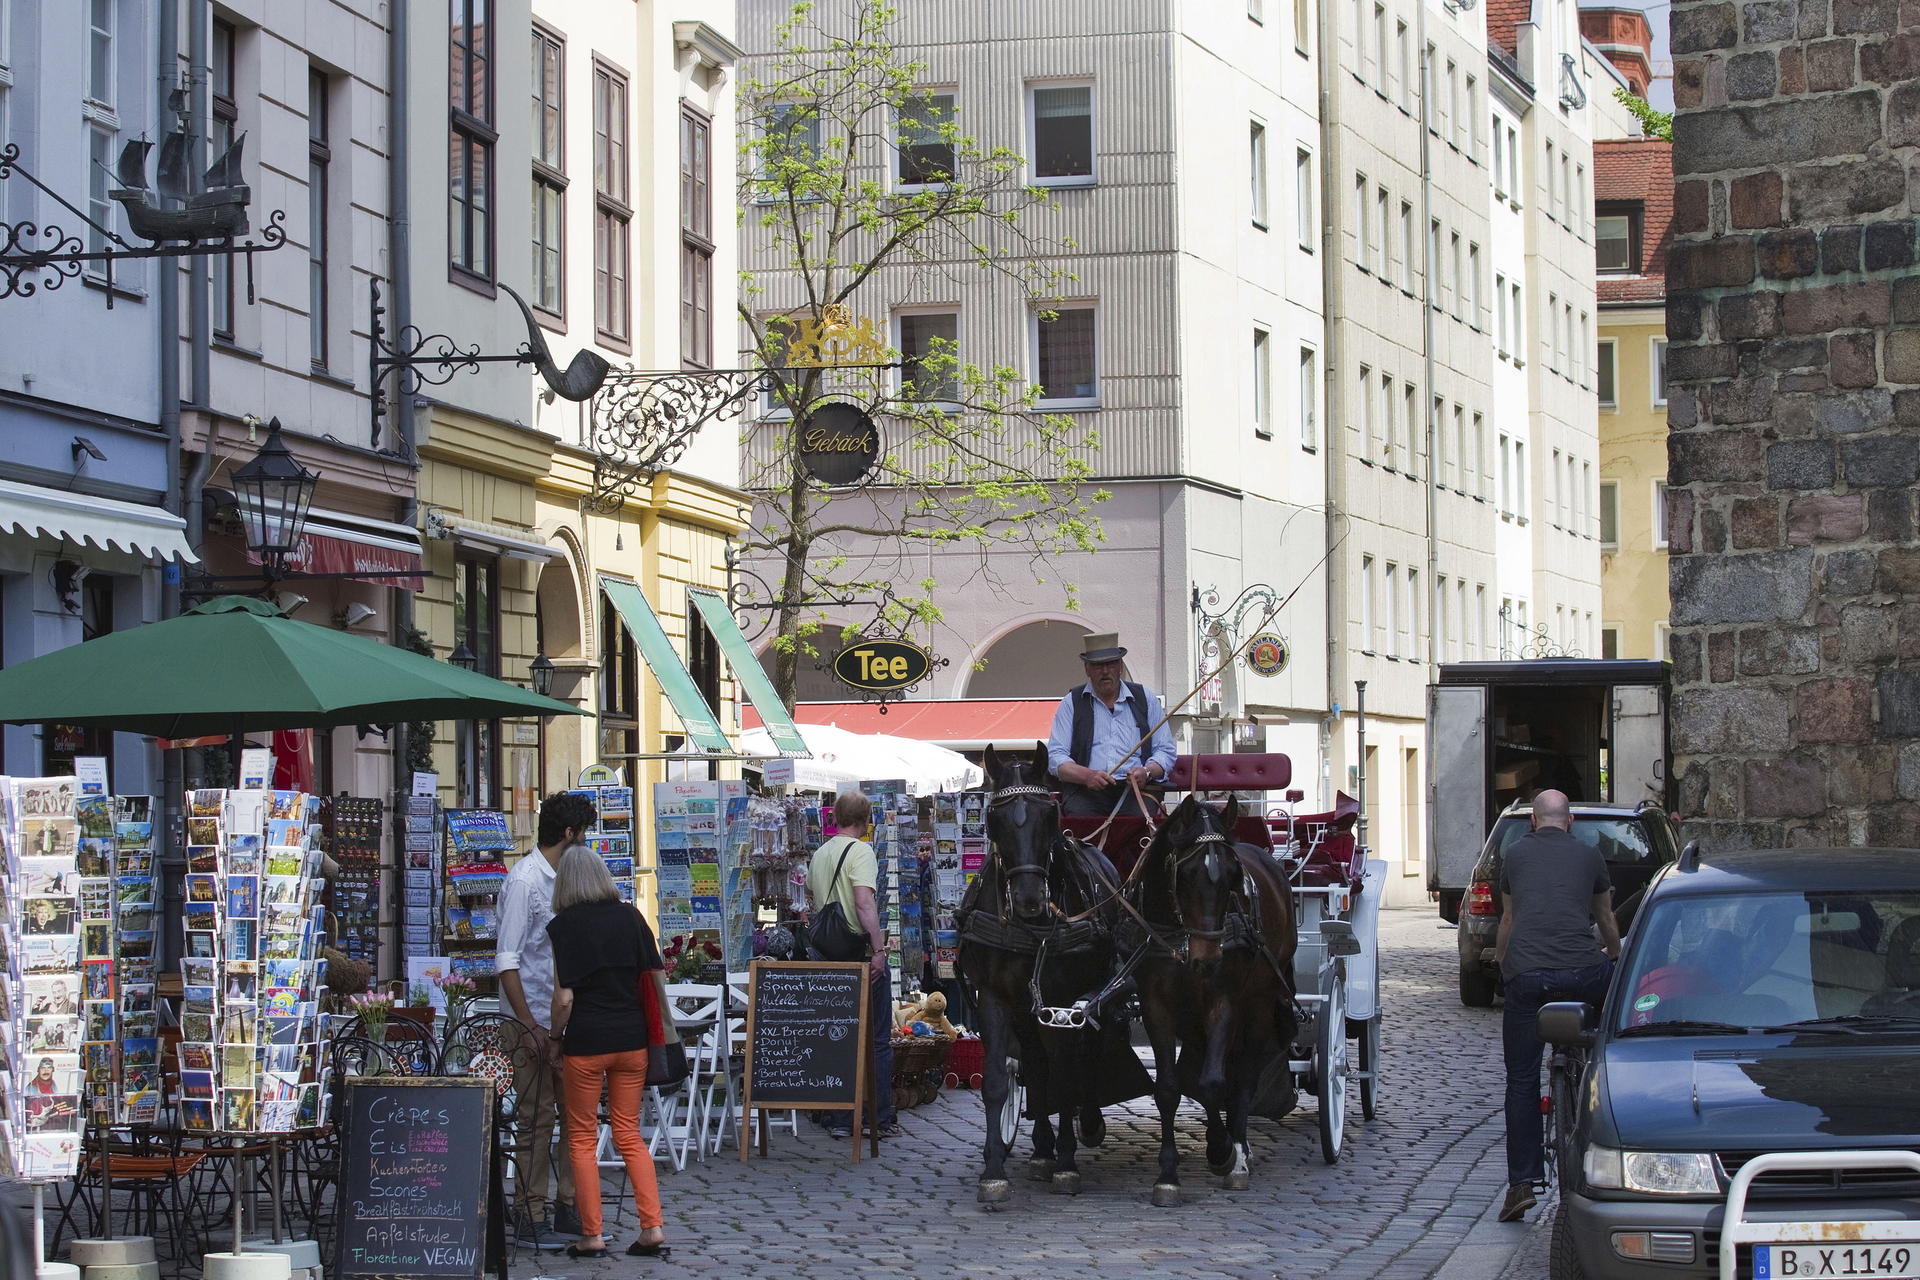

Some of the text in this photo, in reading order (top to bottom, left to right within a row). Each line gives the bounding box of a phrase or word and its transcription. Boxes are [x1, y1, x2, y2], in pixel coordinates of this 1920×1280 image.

[803, 428, 872, 454] Gebäck
[1250, 637, 1283, 652] PAULANER
[854, 650, 909, 681] Tee
[762, 981, 805, 994] Spinat
[760, 1024, 825, 1036] XXL Brezel
[761, 1036, 800, 1047] Donut
[761, 1047, 813, 1059] Fruit Cup
[761, 1055, 803, 1066] Brezel
[758, 1080, 787, 1088] Fresh
[789, 1077, 807, 1088] hot
[369, 1096, 450, 1126] Crêpes
[369, 1129, 407, 1155] Eis
[369, 1177, 427, 1198] Scones
[366, 1223, 466, 1248] Apfelstrudel
[352, 1247, 476, 1266] Florentiner VEGAN
[1781, 1250, 1798, 1275] B
[1759, 1266, 1767, 1274] D
